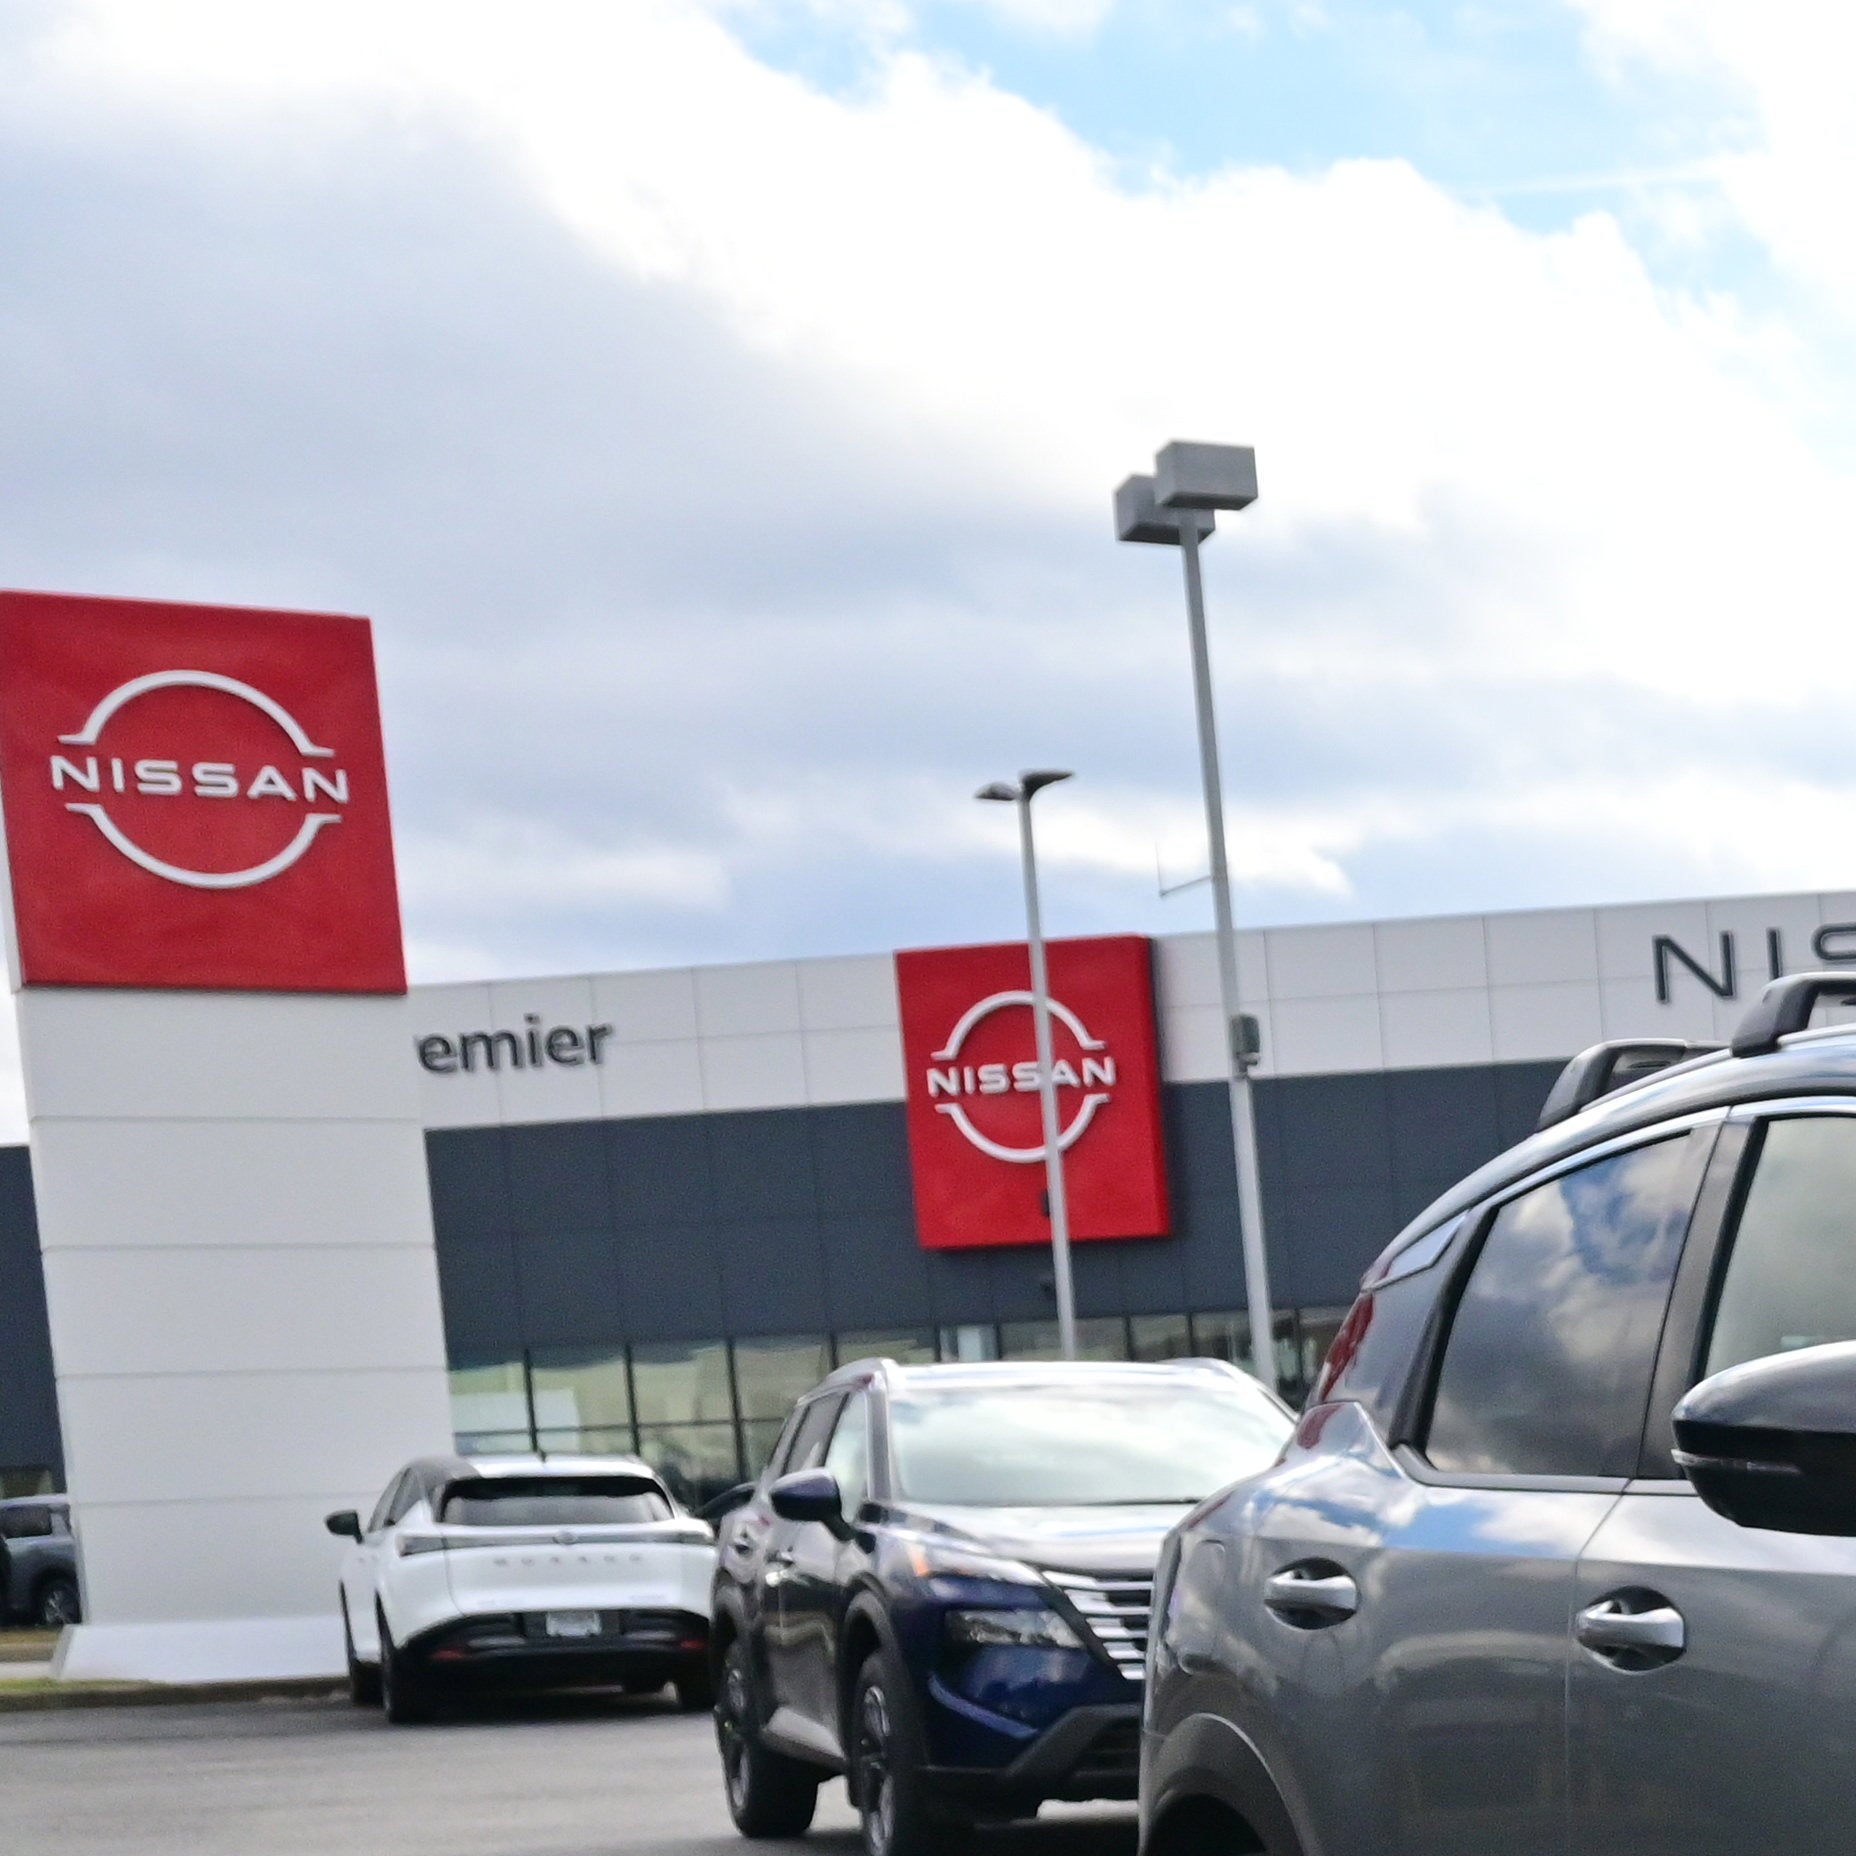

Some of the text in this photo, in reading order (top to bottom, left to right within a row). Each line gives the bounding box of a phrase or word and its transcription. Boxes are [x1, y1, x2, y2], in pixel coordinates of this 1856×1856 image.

[50, 755, 349, 803] NISSAN
[414, 1013, 614, 1073] emier
[926, 1056, 1116, 1097] NISSAN
